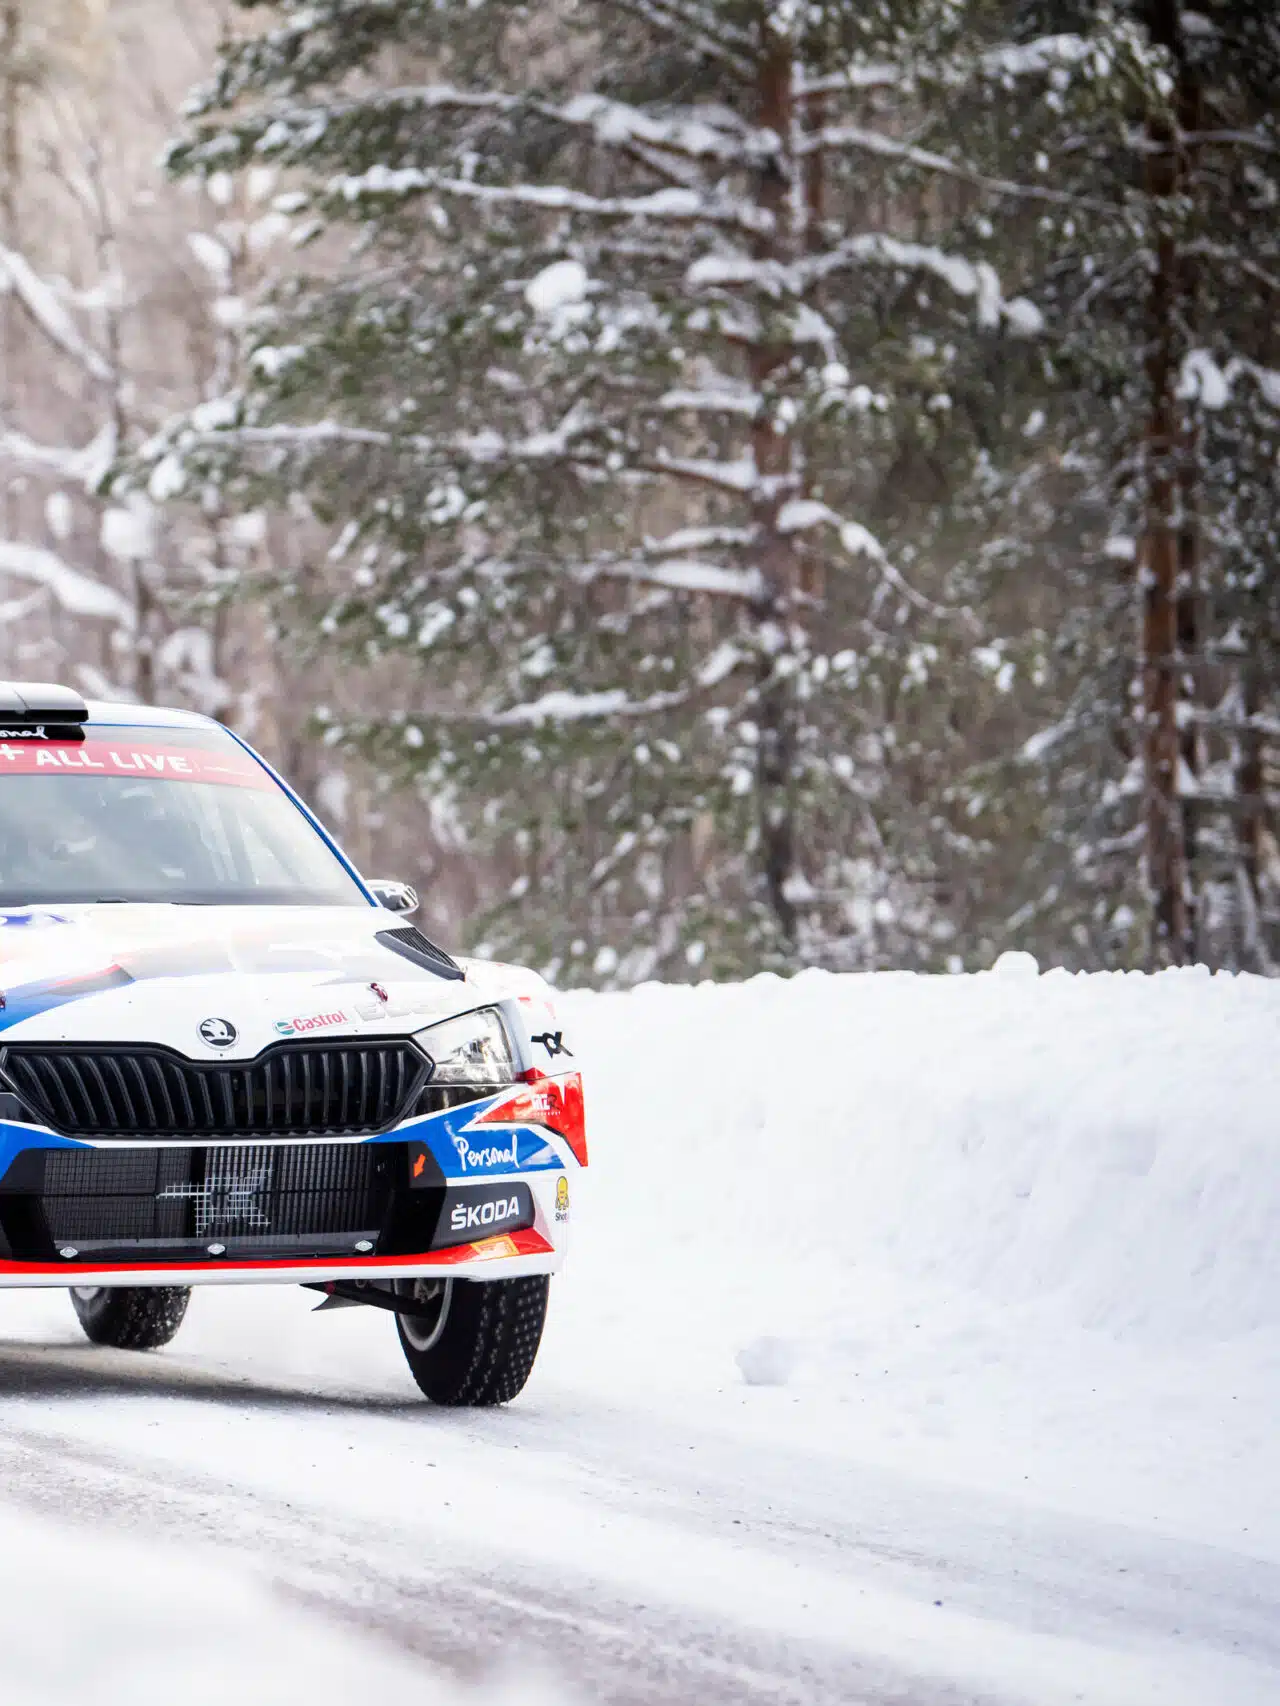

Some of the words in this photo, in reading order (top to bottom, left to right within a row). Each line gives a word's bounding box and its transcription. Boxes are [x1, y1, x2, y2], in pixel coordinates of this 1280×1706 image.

[35, 748, 104, 768] ALL
[109, 752, 194, 773] LIVE
[292, 1009, 349, 1033] Castrol
[457, 1134, 520, 1171] Personal
[451, 1196, 520, 1231] ŠKODA
